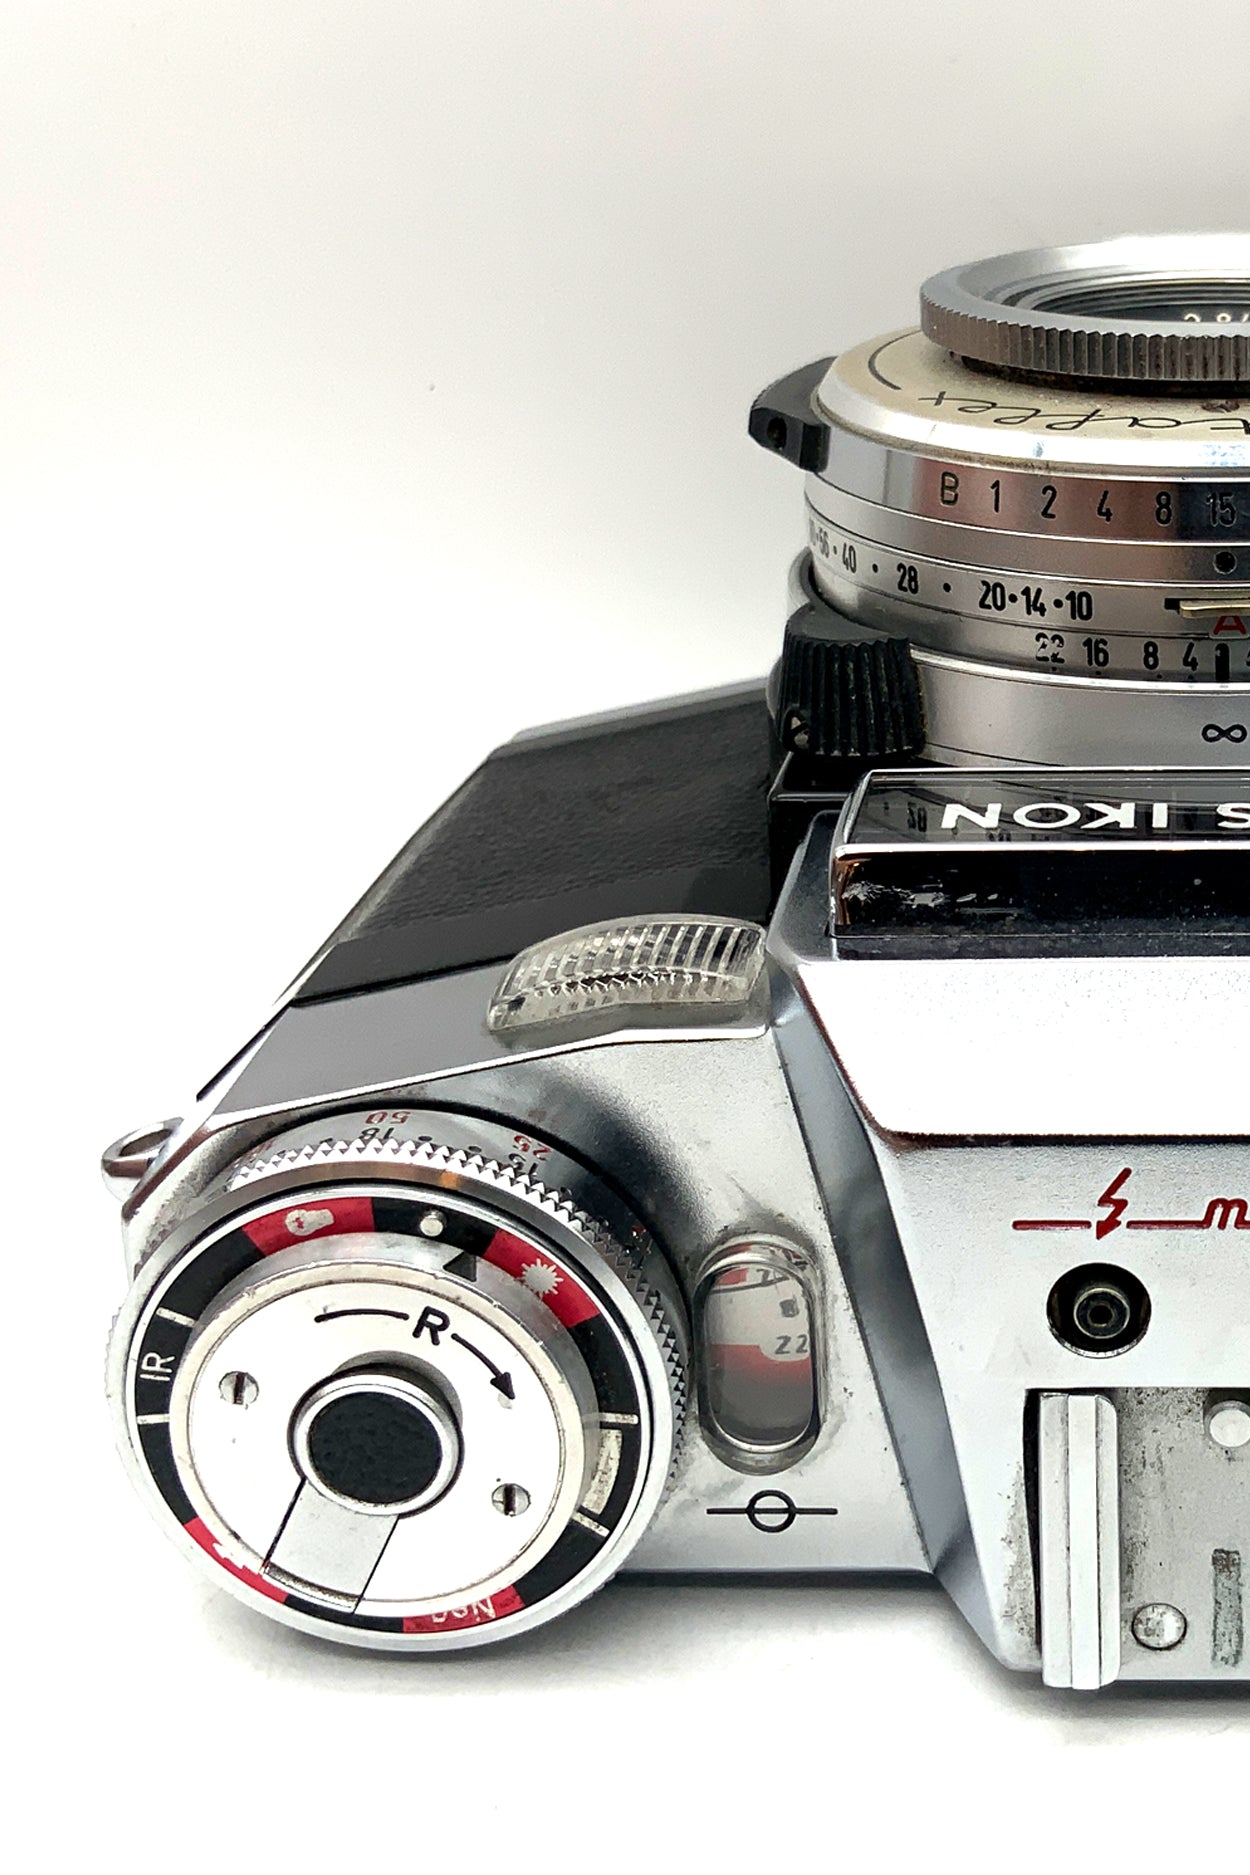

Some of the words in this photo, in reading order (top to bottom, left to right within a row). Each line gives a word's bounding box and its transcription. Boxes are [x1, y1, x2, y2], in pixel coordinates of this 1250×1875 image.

[940, 472, 959, 505] B
[990, 480, 1000, 513] 1
[1041, 486, 1056, 519] 2
[1097, 490, 1113, 522] 4
[1156, 491, 1172, 525] 8
[1206, 490, 1237, 526] 15
[842, 543, 857, 573] 40
[897, 563, 919, 594] 28
[979, 580, 1006, 612] 20
[1020, 586, 1048, 617] 14
[1065, 590, 1094, 621] 10
[1213, 615, 1247, 636] A
[1083, 638, 1109, 669] 16
[1143, 641, 1160, 671] 8
[1182, 642, 1198, 671] 4
[941, 803, 1168, 829] IKON
[365, 1110, 411, 1125] 50
[413, 1306, 450, 1345] R
[775, 1334, 809, 1355] 22
[140, 1352, 175, 1382] IR
